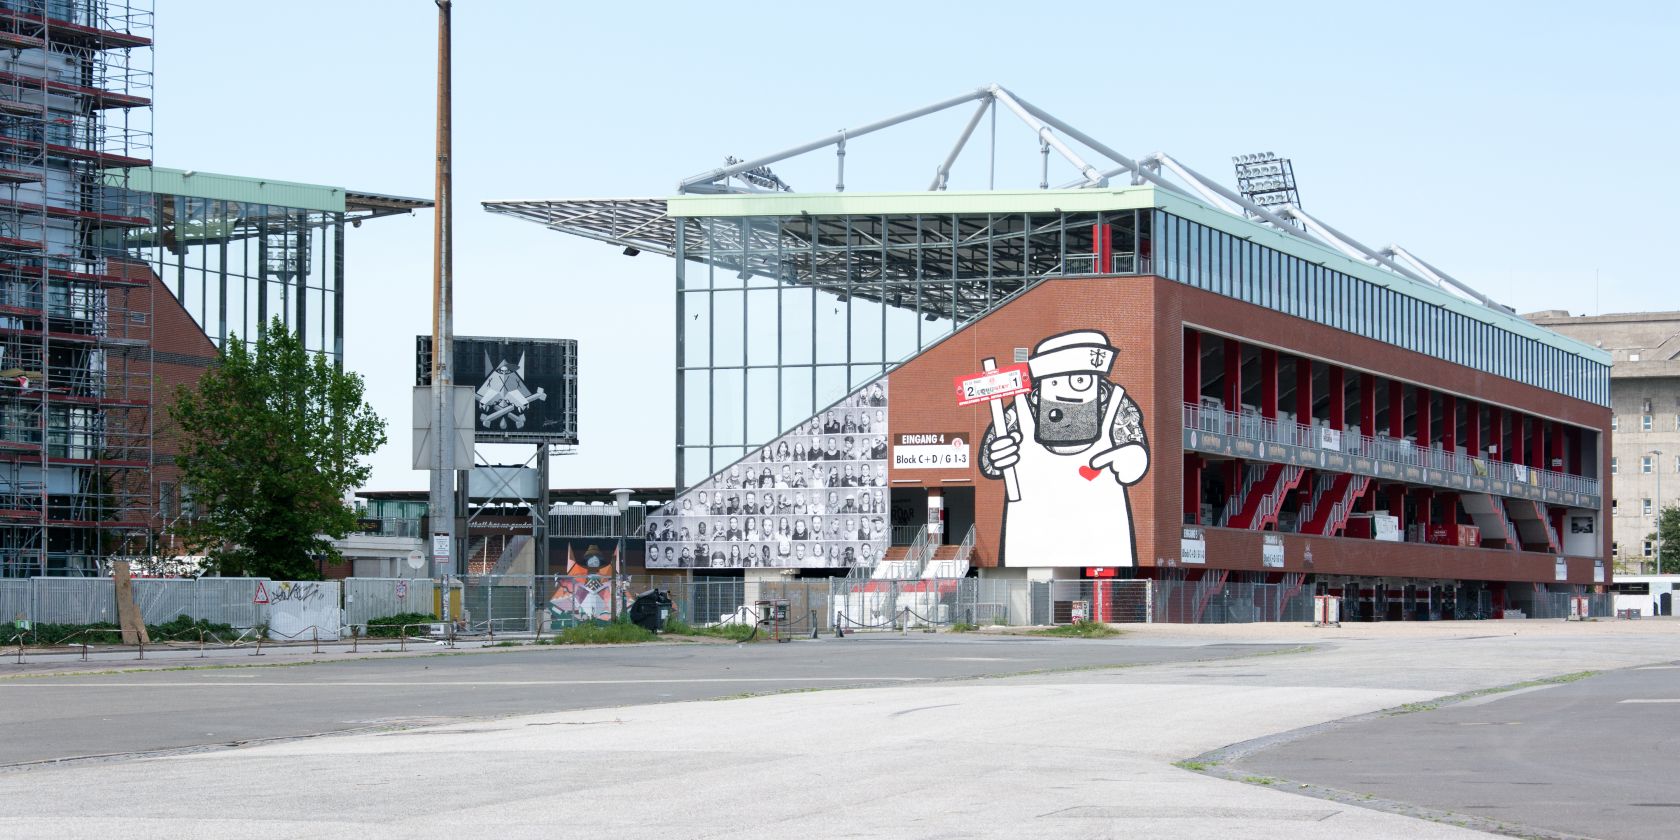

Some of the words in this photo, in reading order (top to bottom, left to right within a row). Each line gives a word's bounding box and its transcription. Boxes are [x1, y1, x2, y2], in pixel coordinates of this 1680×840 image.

[1012, 377, 1018, 387] 1
[967, 386, 975, 397] 2
[902, 434, 937, 445] EINGANG
[939, 434, 945, 444] 4
[896, 454, 916, 464] Block
[945, 454, 951, 463] G
[954, 454, 967, 463] 1-3
